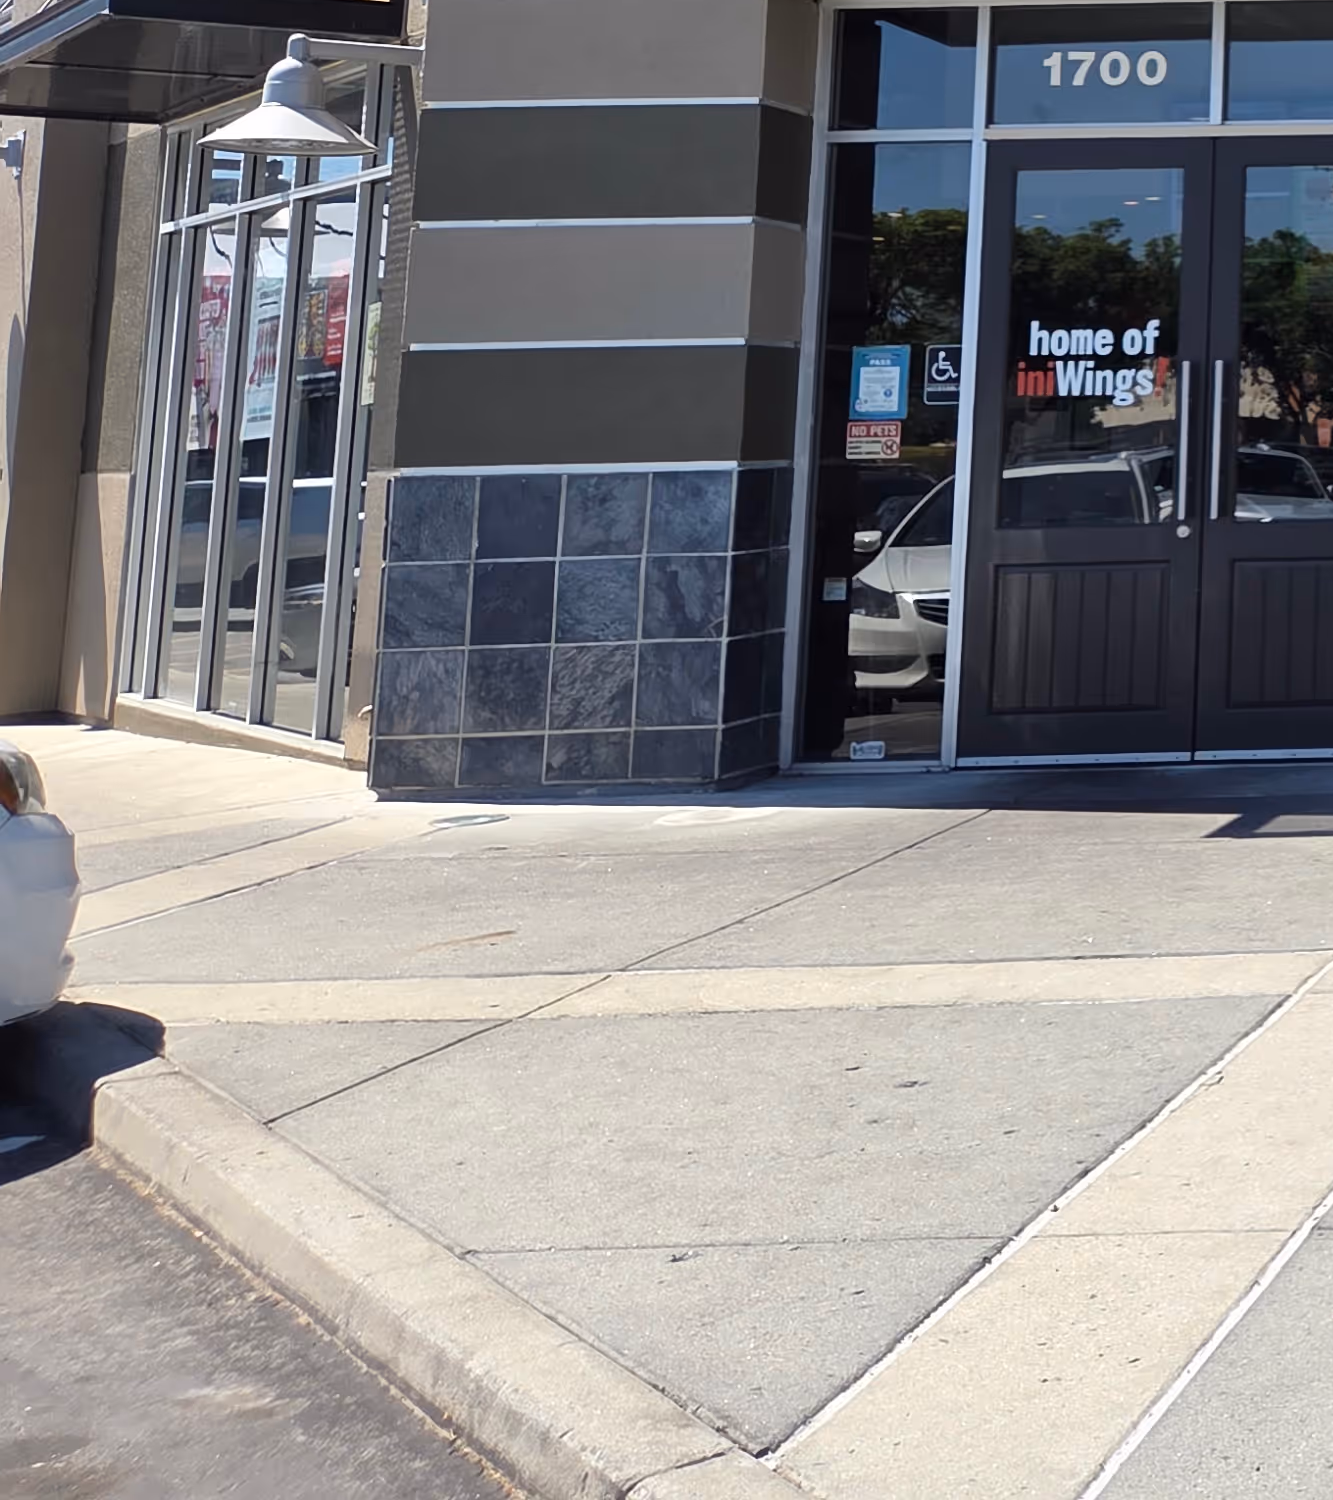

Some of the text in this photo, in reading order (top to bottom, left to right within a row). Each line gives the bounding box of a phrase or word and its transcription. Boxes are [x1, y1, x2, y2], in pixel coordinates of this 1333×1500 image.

[1043, 50, 1168, 87] 1700
[1029, 319, 1160, 357] home of
[1016, 356, 1170, 407] iniWings!
[851, 425, 897, 437] NO PETS
